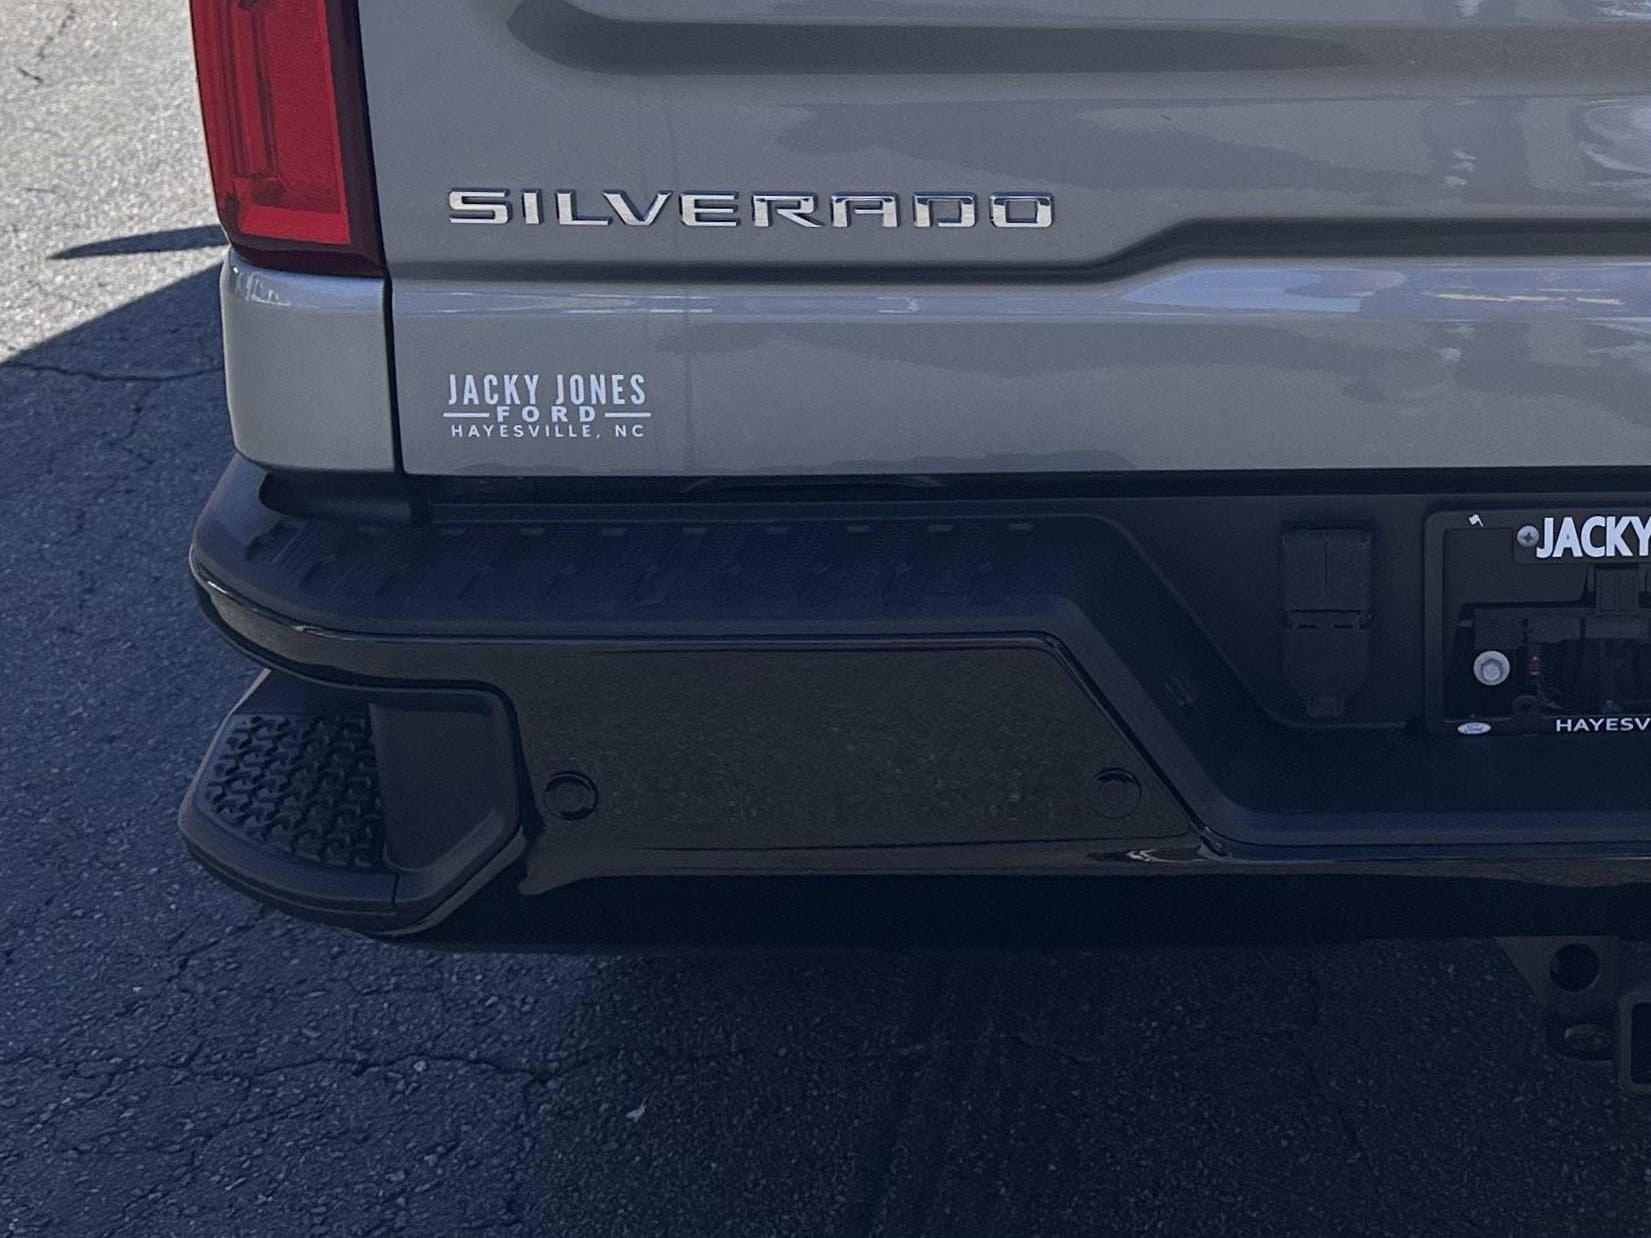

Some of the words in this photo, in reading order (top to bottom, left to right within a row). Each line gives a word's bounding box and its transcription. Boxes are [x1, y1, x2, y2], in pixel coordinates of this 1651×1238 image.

[446, 187, 1056, 230] SILVERADO
[448, 374, 540, 405] JACKY
[555, 374, 646, 405] JONES
[496, 405, 597, 422] FORD
[451, 424, 601, 439] HAYESVILLE,
[614, 424, 645, 438] NC
